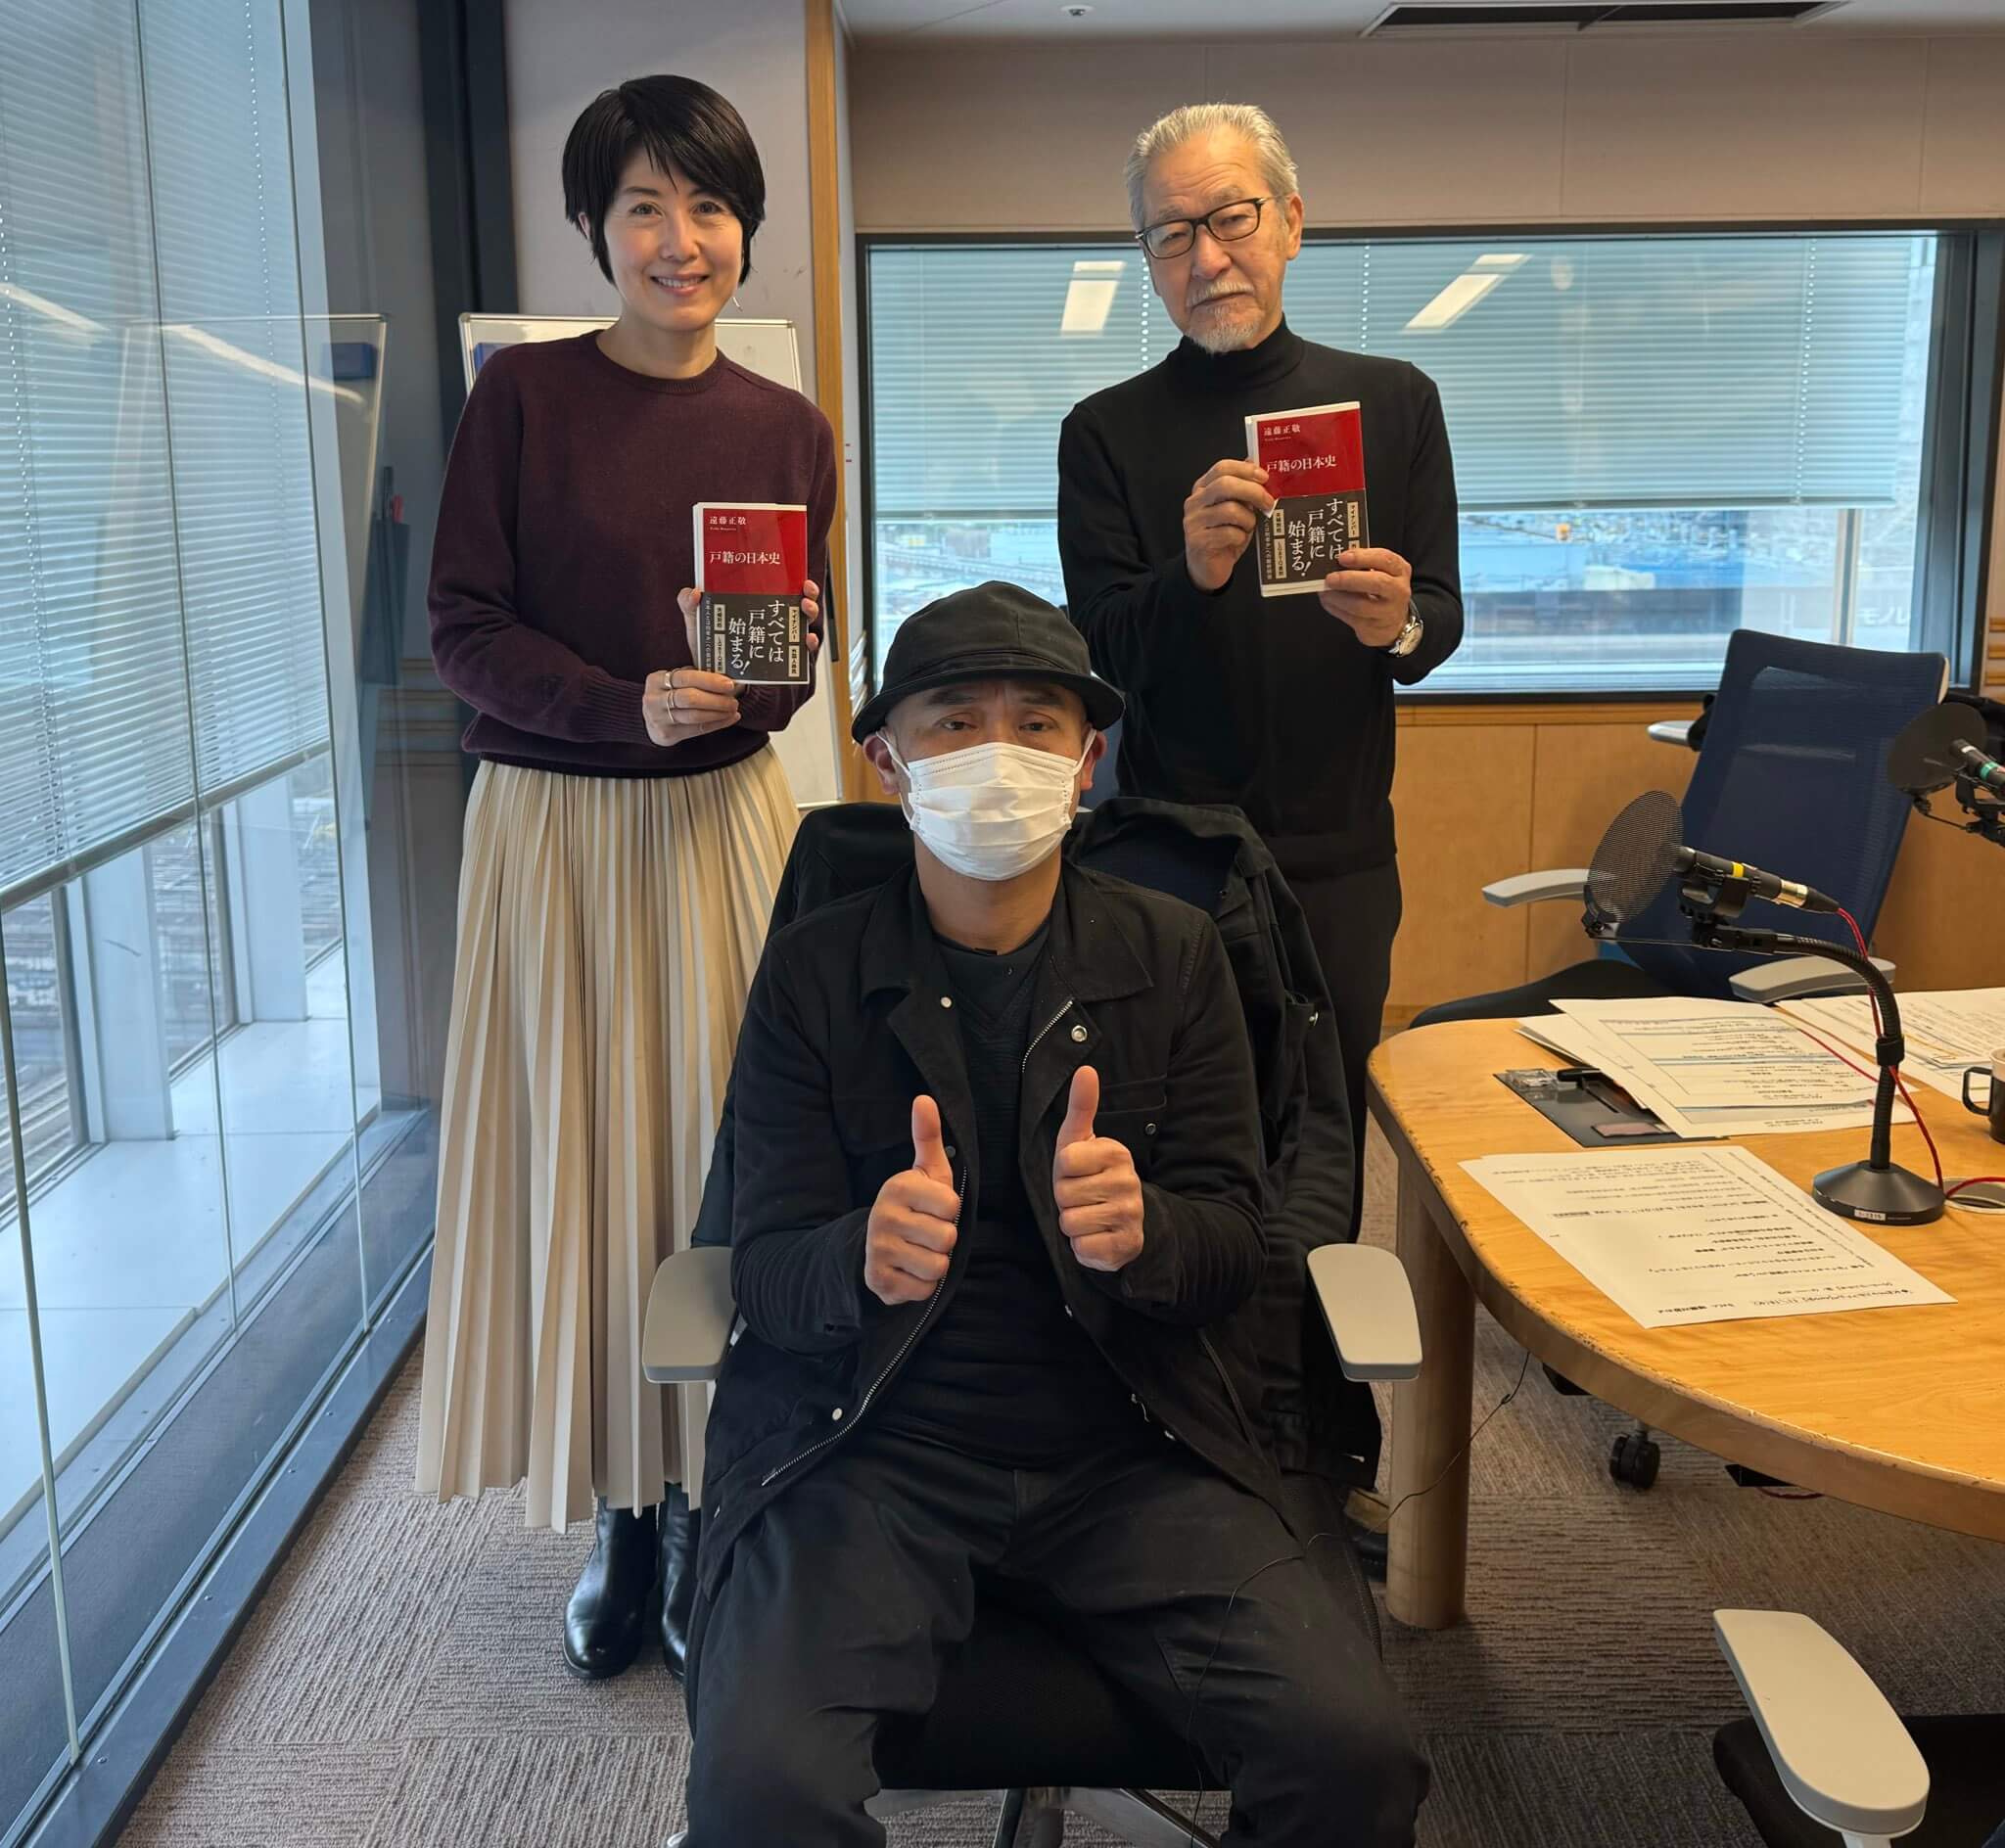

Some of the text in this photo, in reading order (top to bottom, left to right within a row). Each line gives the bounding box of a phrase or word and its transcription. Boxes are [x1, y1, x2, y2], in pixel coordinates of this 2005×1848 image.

[1264, 424, 1301, 437] 遠藤正敬
[1267, 454, 1338, 473] 戸籍の日本史
[709, 516, 746, 526] 遠藤正敬
[1308, 509, 1326, 560] 戸籍に
[1326, 498, 1345, 561] すべては
[709, 550, 781, 565] 戸籍の日本史
[728, 618, 751, 676] 始まる!
[748, 609, 766, 659] 戸籍に
[767, 599, 785, 663] すべては
